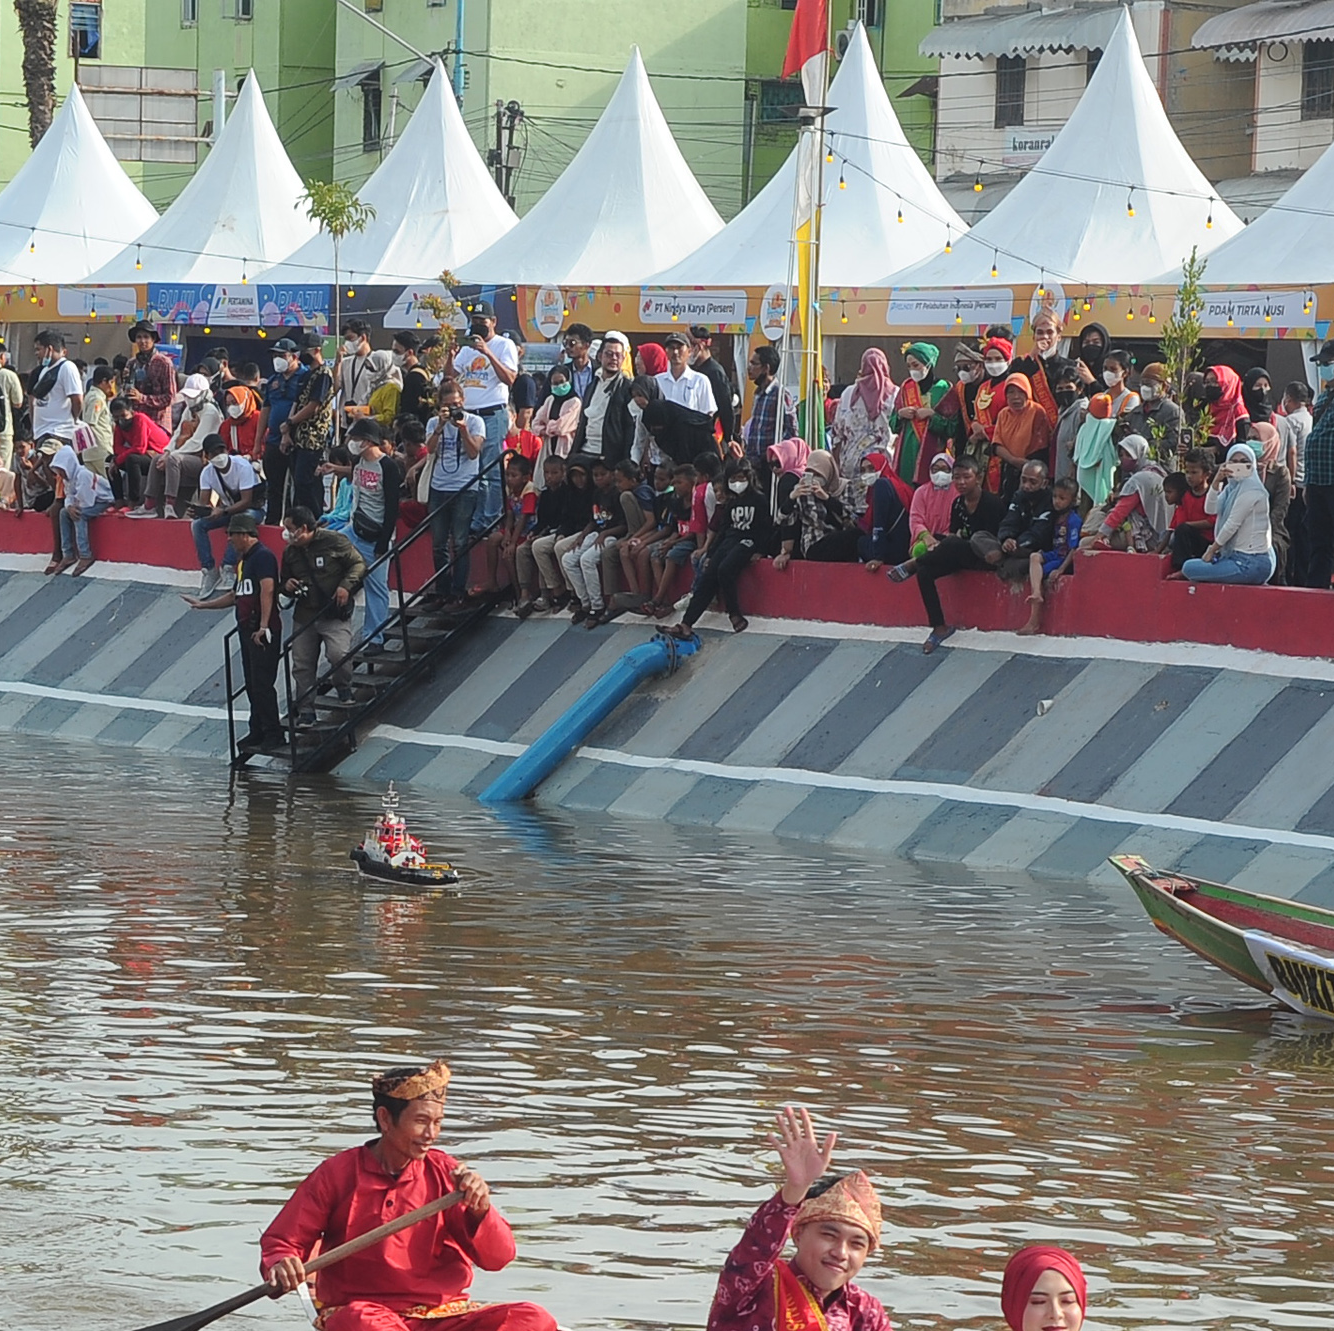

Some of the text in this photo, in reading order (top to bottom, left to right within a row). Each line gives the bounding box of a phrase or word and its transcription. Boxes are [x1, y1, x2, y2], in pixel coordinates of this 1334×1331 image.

[654, 302, 736, 315] PT Nindya Karya (Persero)
[1208, 305, 1285, 316] PDAM TIRTA MUSI
